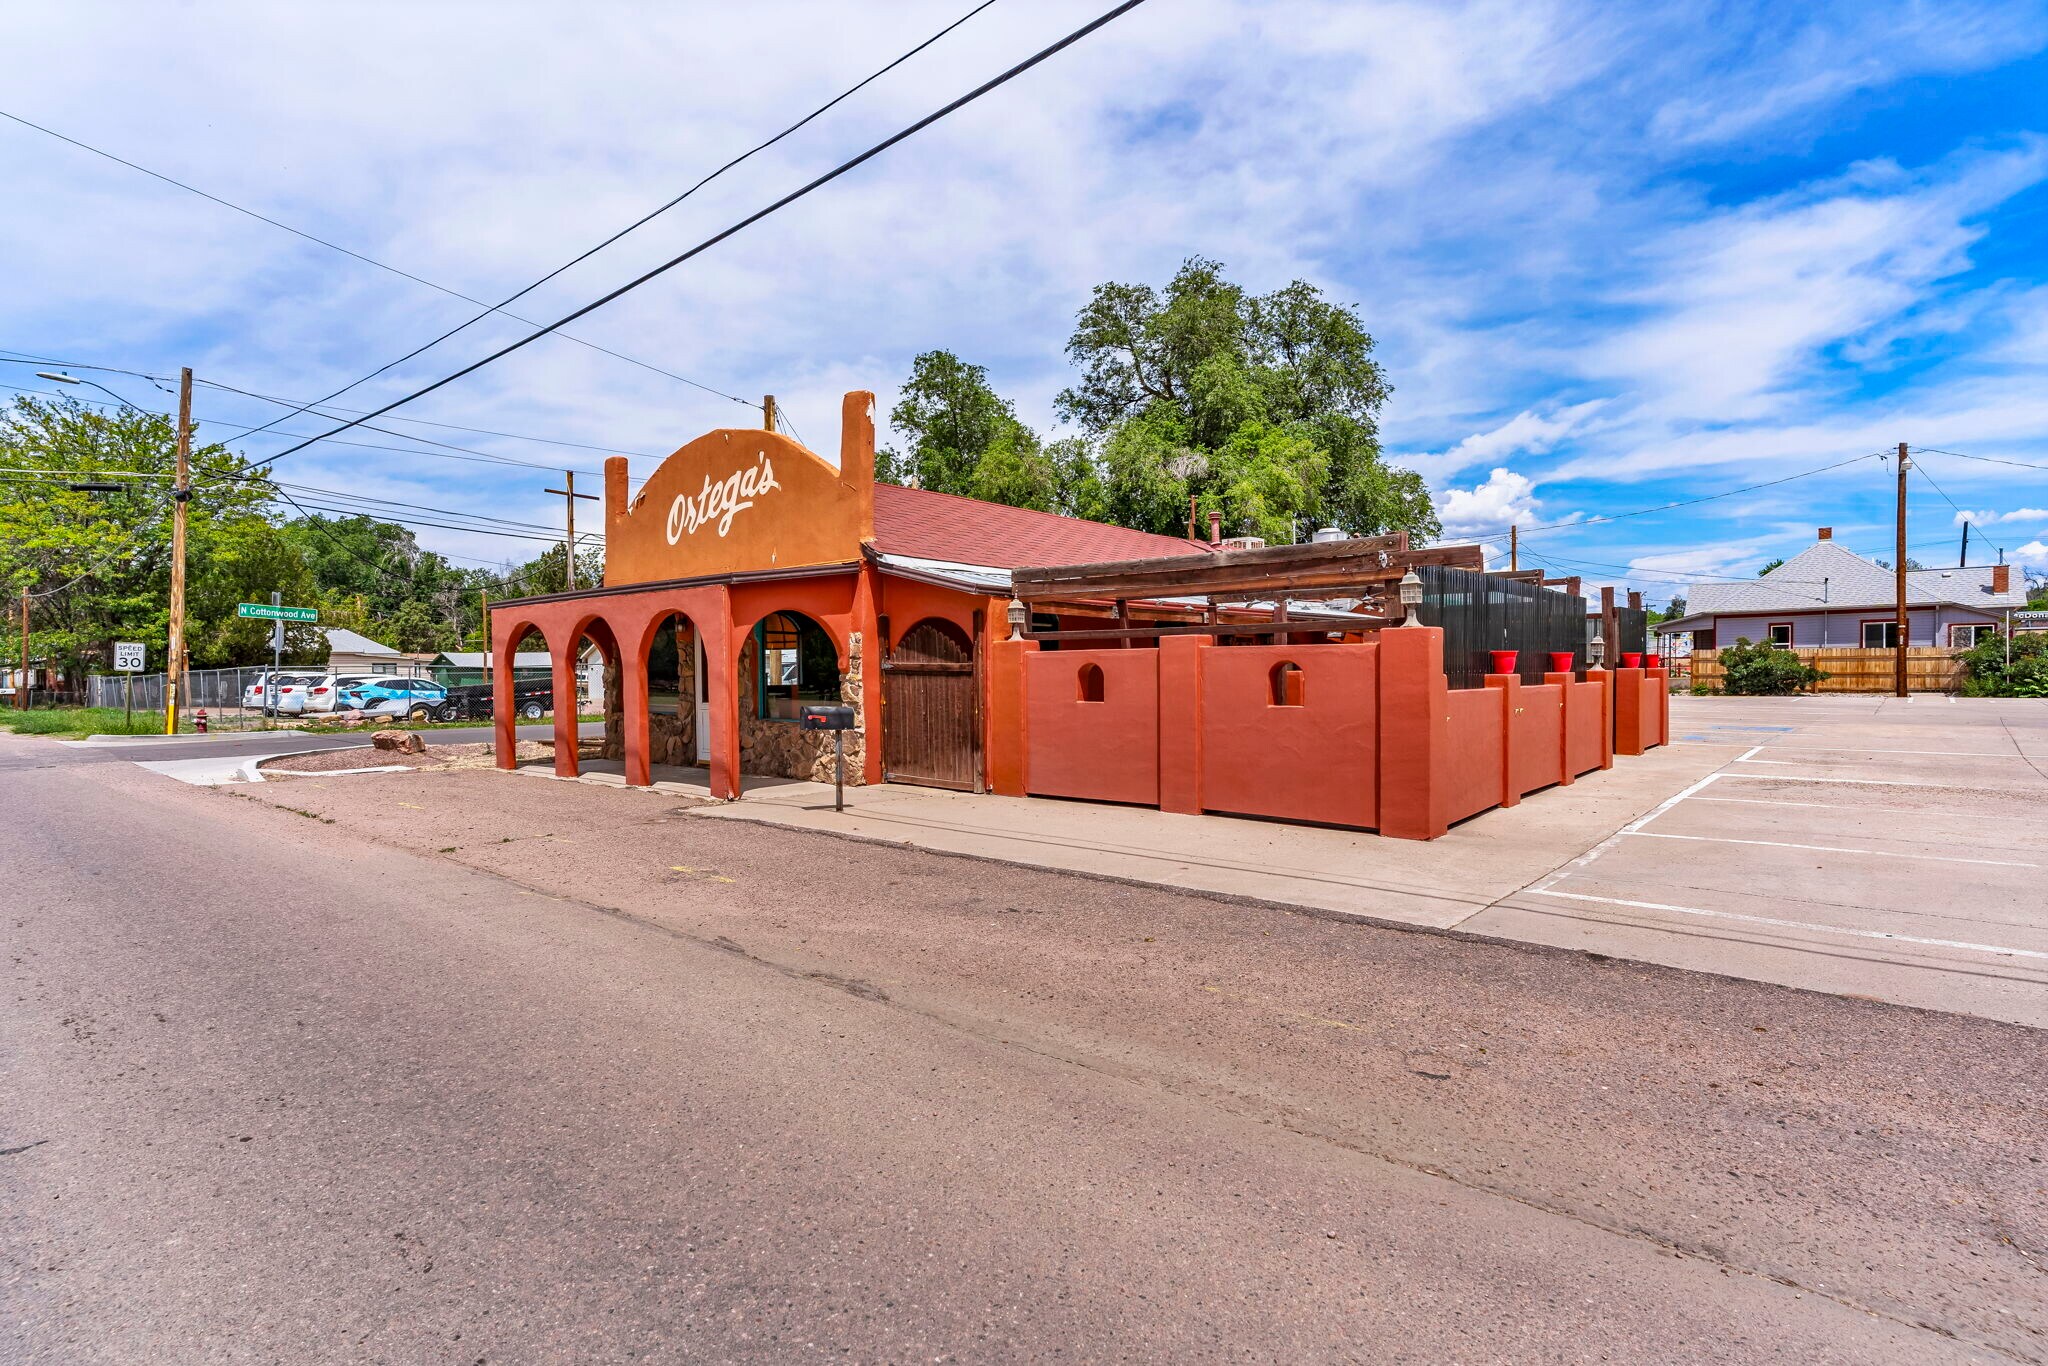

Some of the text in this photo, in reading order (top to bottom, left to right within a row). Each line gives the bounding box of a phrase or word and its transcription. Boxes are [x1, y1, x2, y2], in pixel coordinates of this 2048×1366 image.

[666, 450, 781, 546] Ortega's
[240, 606, 316, 619] N Cottonwood Ave
[118, 657, 141, 668] 30
